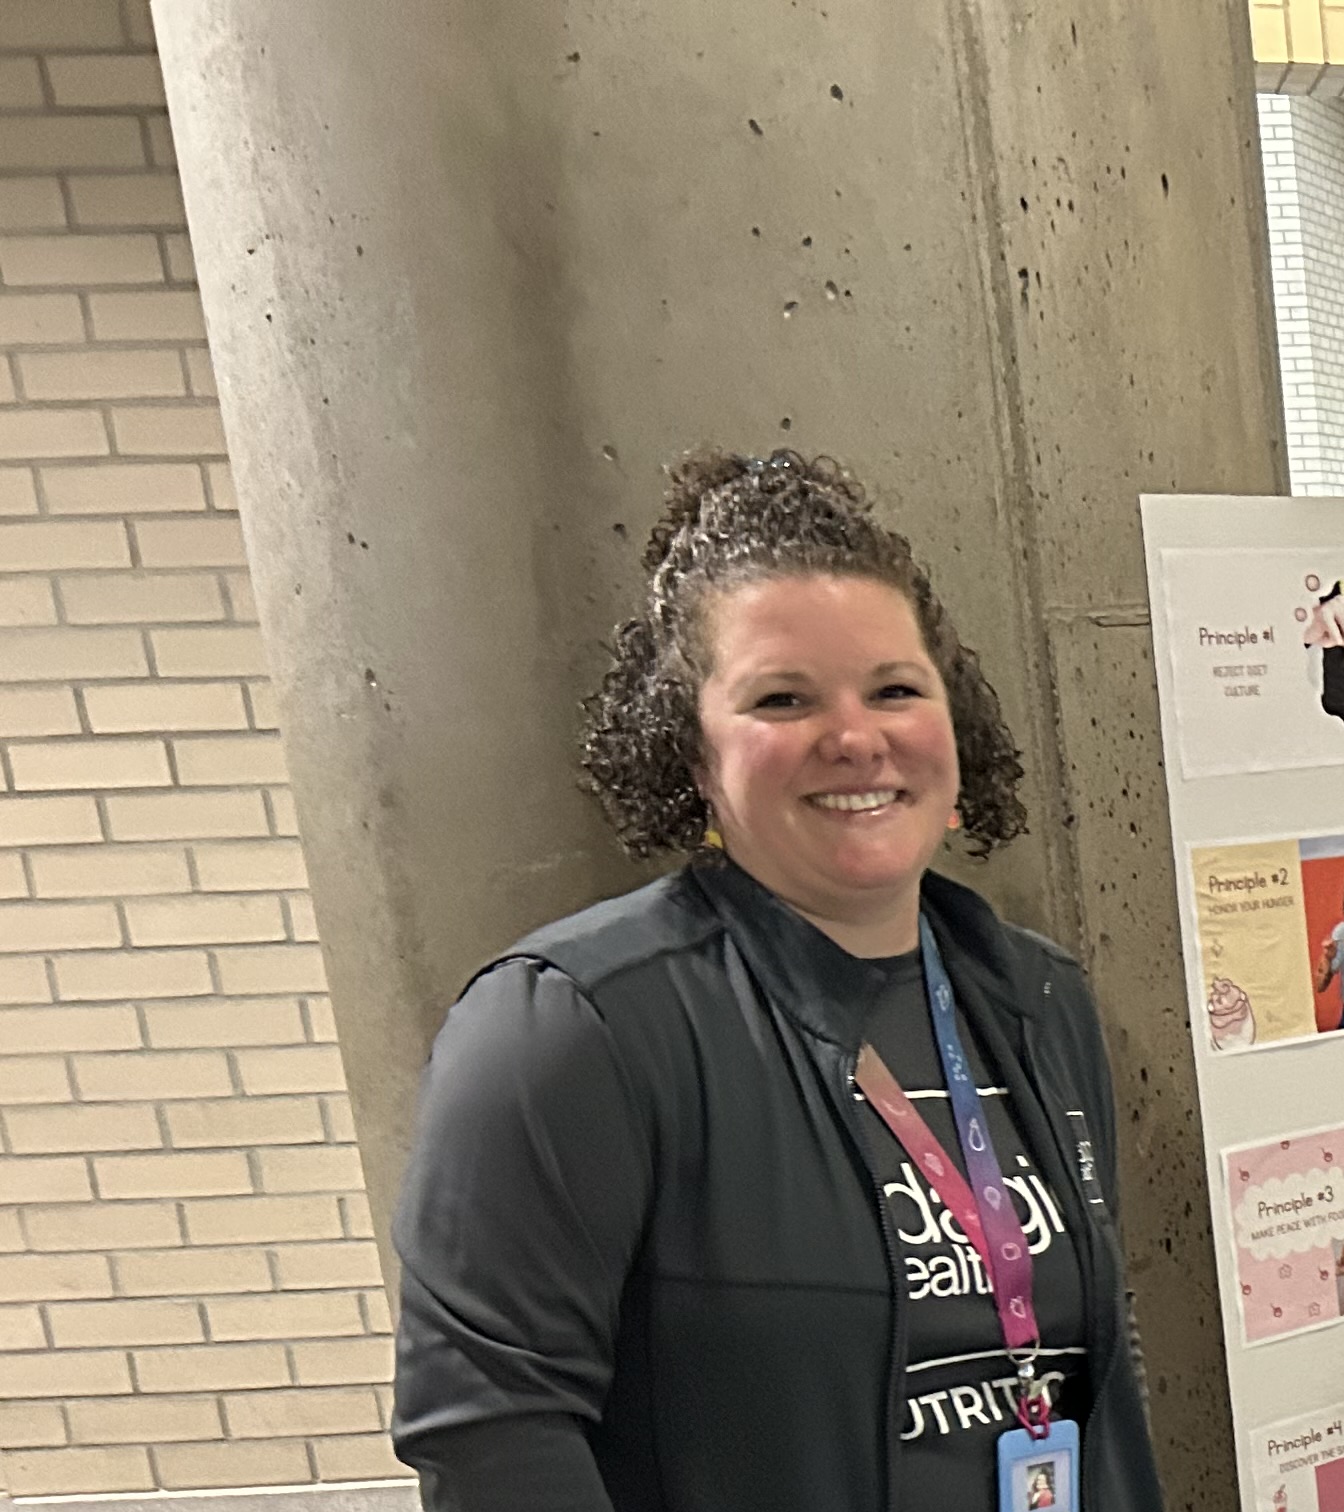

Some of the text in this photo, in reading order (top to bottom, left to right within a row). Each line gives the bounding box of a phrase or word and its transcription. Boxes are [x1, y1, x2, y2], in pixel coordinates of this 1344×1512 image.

[1198, 626, 1258, 649] Principle
[1208, 868, 1289, 894] Principle #2
[1258, 1185, 1334, 1219] Principle #3
[1268, 1420, 1342, 1456] Principle #4
